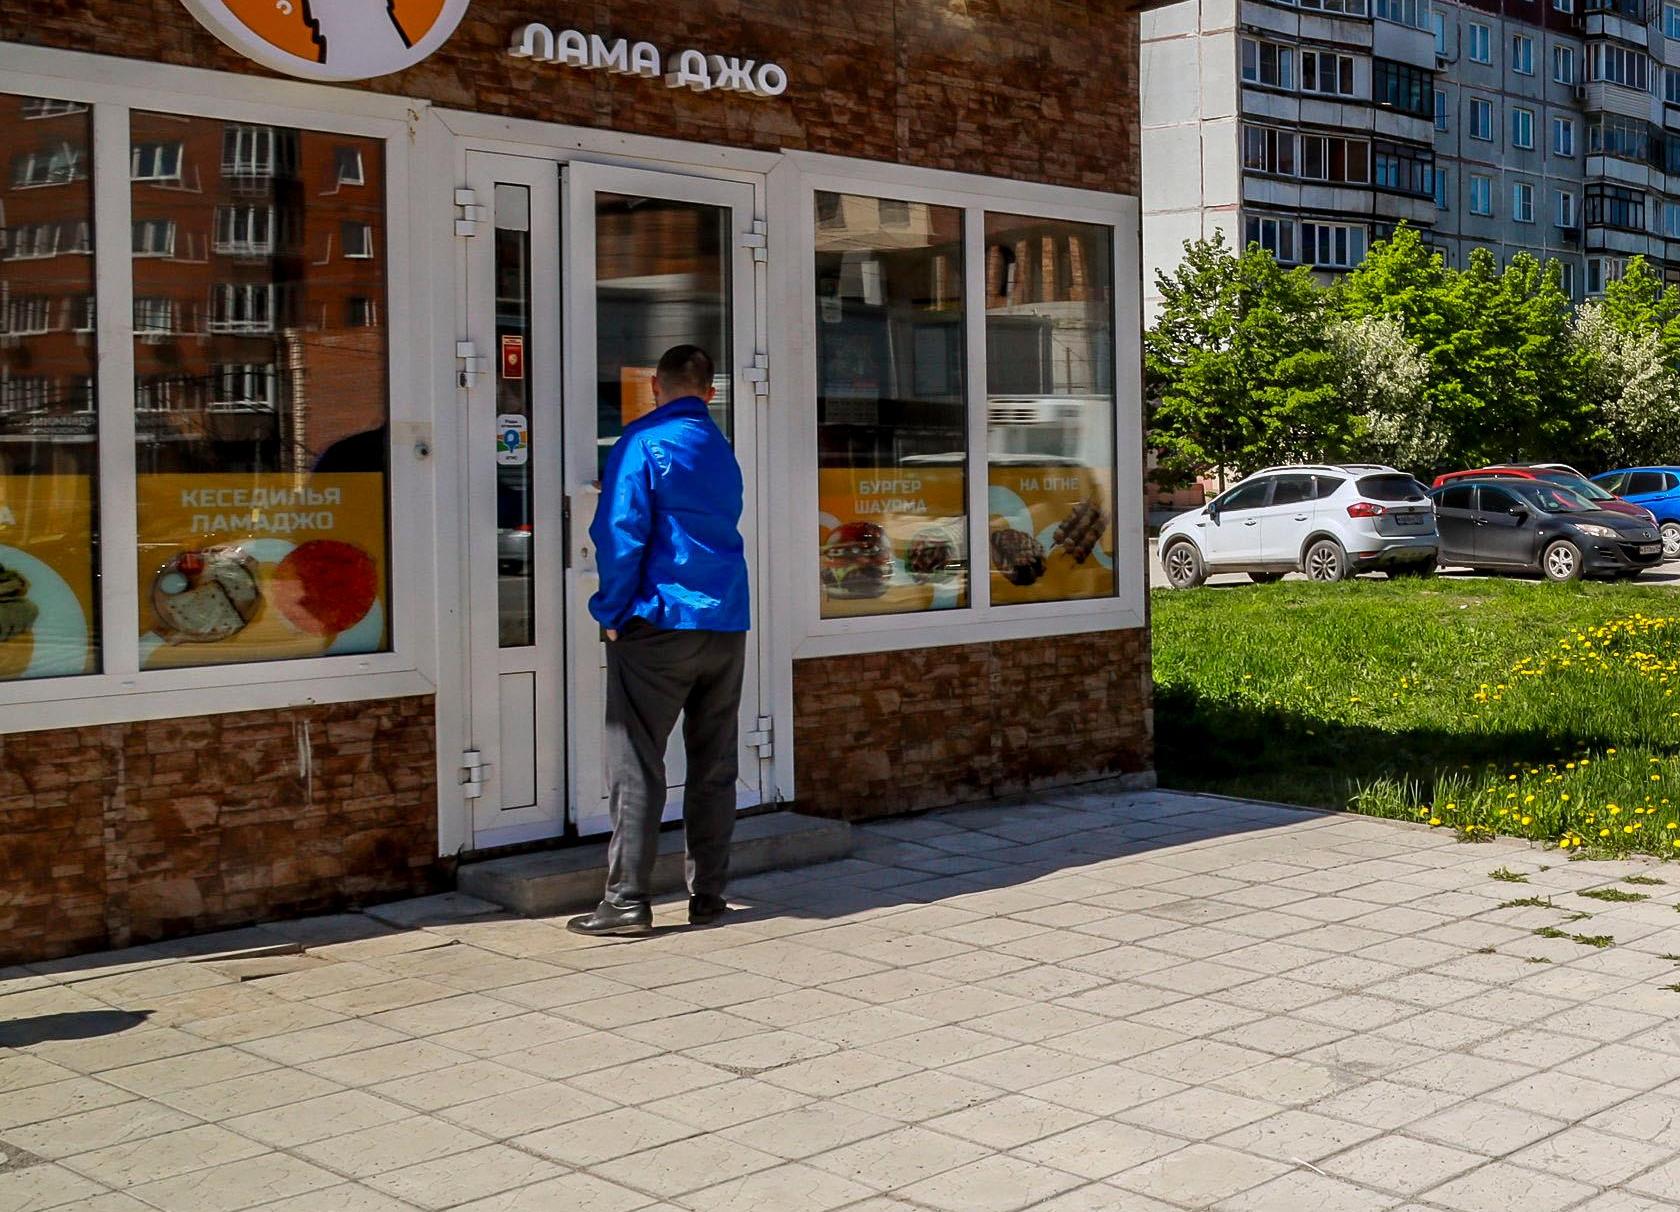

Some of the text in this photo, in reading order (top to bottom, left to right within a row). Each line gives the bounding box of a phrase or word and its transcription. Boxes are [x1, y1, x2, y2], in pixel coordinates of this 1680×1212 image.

[513, 22, 789, 97] ЛАМА ДЖО
[858, 479, 922, 496] БУРГЕР
[1019, 477, 1081, 492] НА ОГНЕ
[180, 486, 343, 509] КЕСЕДИЛЬЯ
[854, 499, 929, 515] ШАУРМА
[190, 511, 335, 534] ЛАМАДЖО
